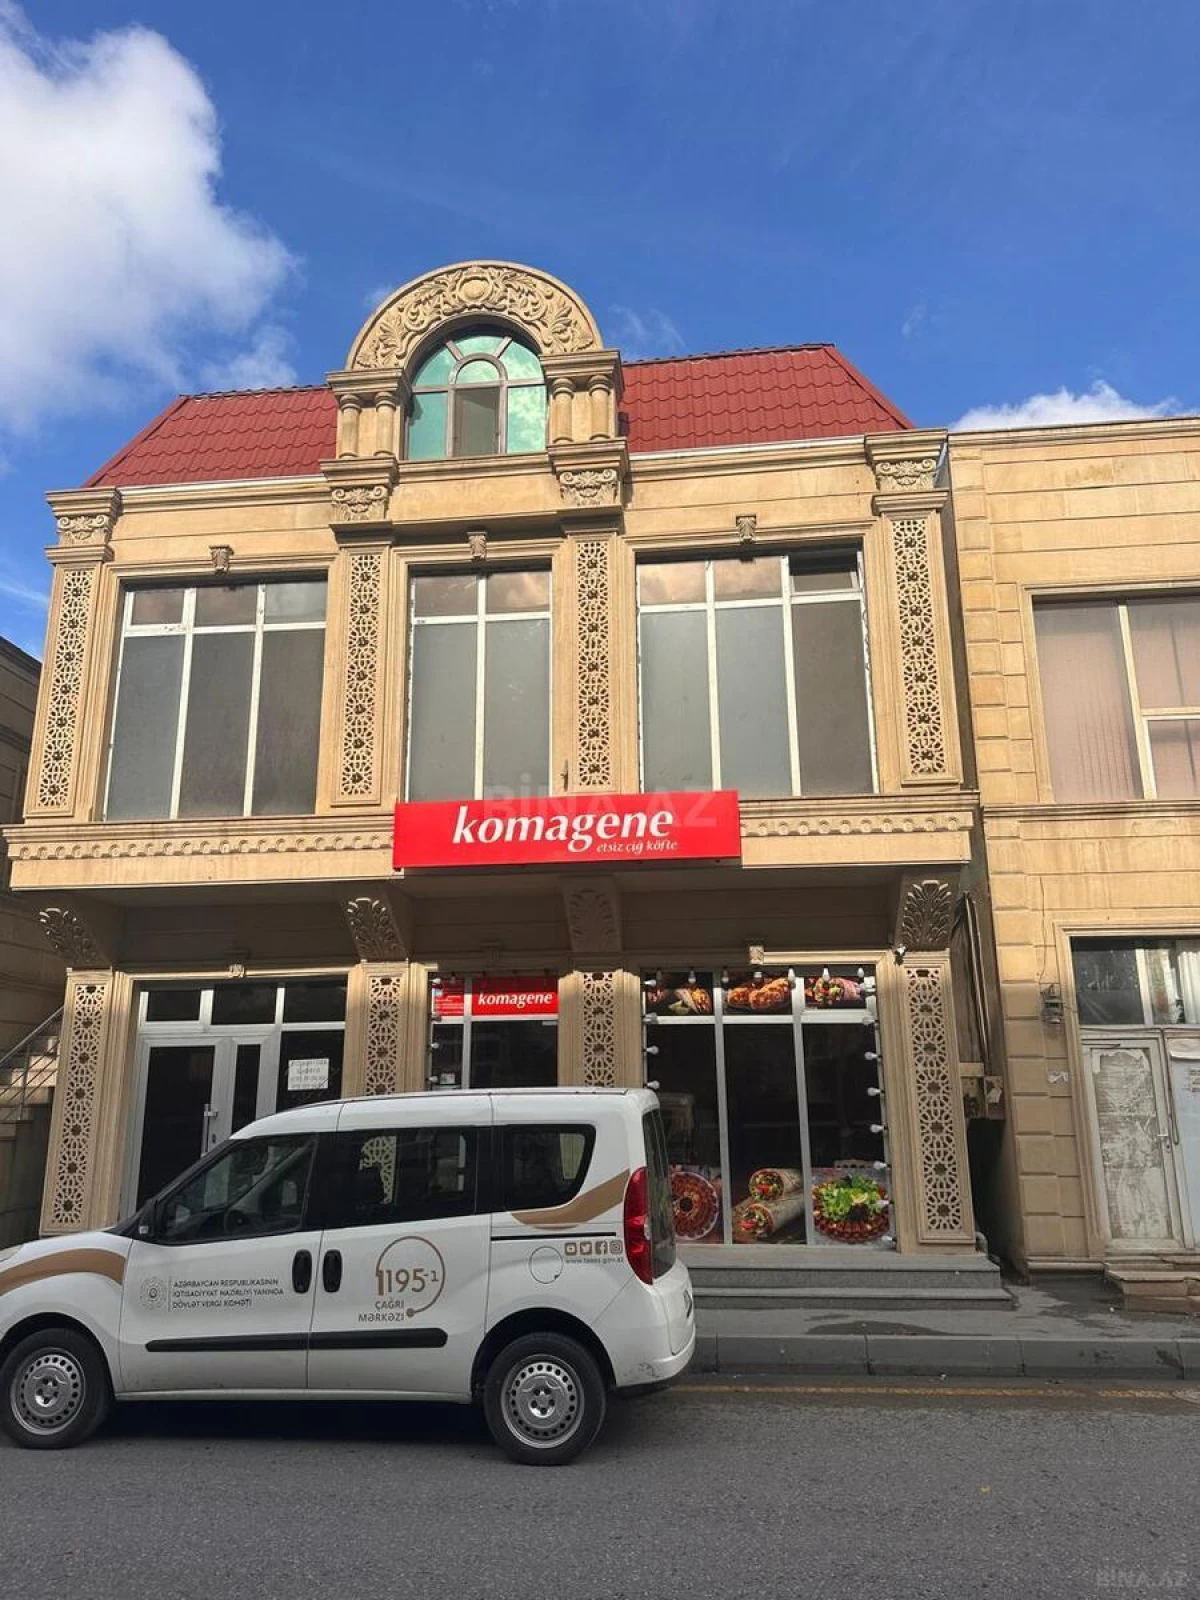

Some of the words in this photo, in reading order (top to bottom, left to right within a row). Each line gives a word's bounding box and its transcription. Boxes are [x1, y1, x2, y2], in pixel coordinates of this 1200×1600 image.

[453, 804, 673, 852] komagene
[596, 842, 624, 853] etsiz
[646, 839, 678, 852] köfte
[478, 992, 553, 1008] komagene
[375, 1298, 405, 1310] ÇAĞRI
